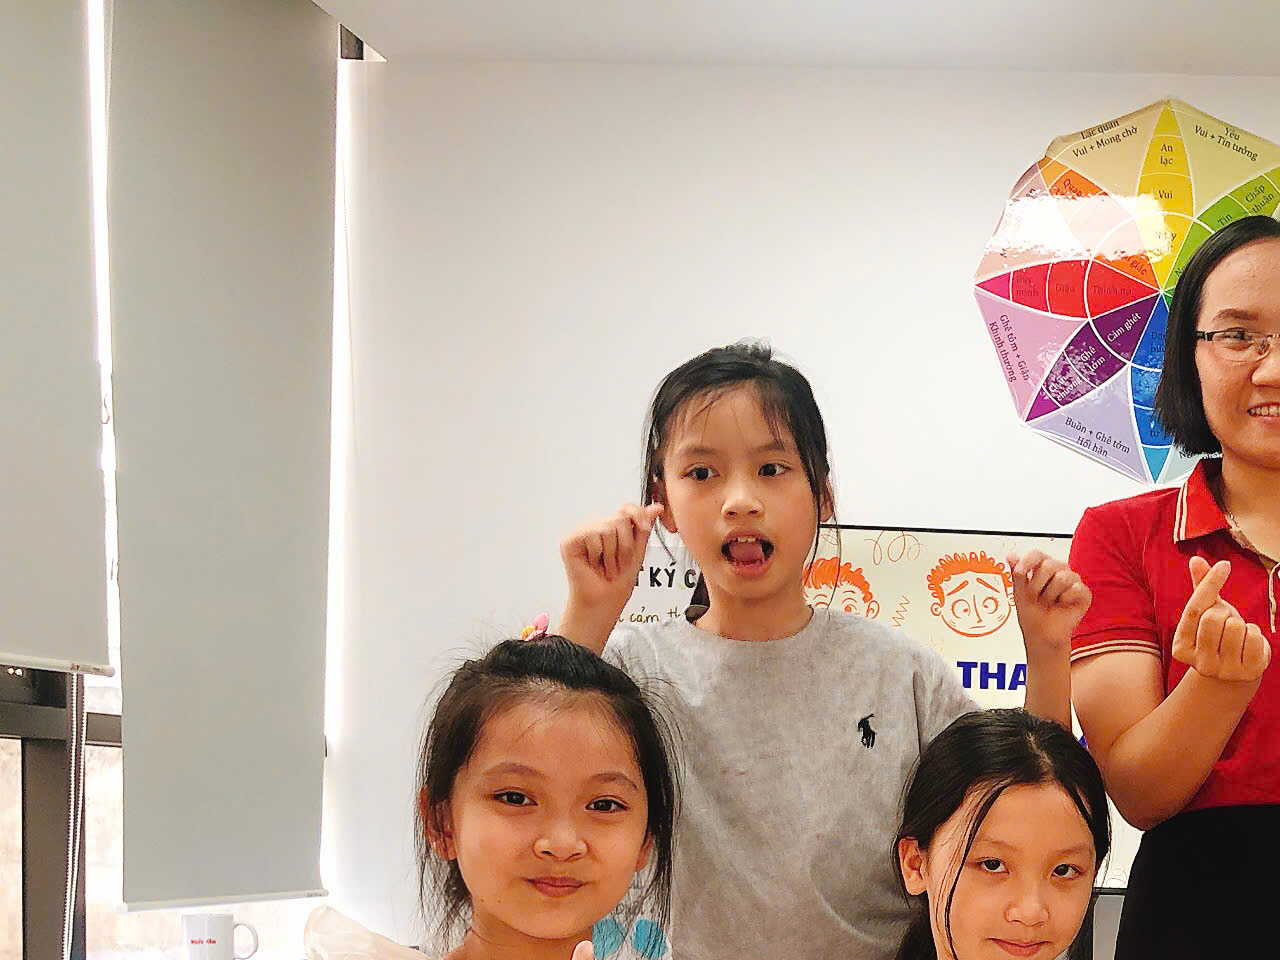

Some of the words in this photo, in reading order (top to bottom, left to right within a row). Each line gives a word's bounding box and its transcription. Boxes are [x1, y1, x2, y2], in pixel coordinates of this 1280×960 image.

[1194, 124, 1209, 139] Vui
[1095, 134, 1122, 151] Mong
[1160, 143, 1173, 153] An
[1158, 190, 1174, 200] Vui
[1217, 214, 1233, 227] Tin
[989, 321, 1004, 348] Khinh
[1065, 416, 1088, 435] Buồn
[1095, 430, 1113, 446] Ghê
[1112, 439, 1131, 455] tởm
[1076, 435, 1093, 450] Hối
[1092, 441, 1109, 458] hận
[649, 561, 677, 588] KÝ
[956, 660, 1028, 691] THA
